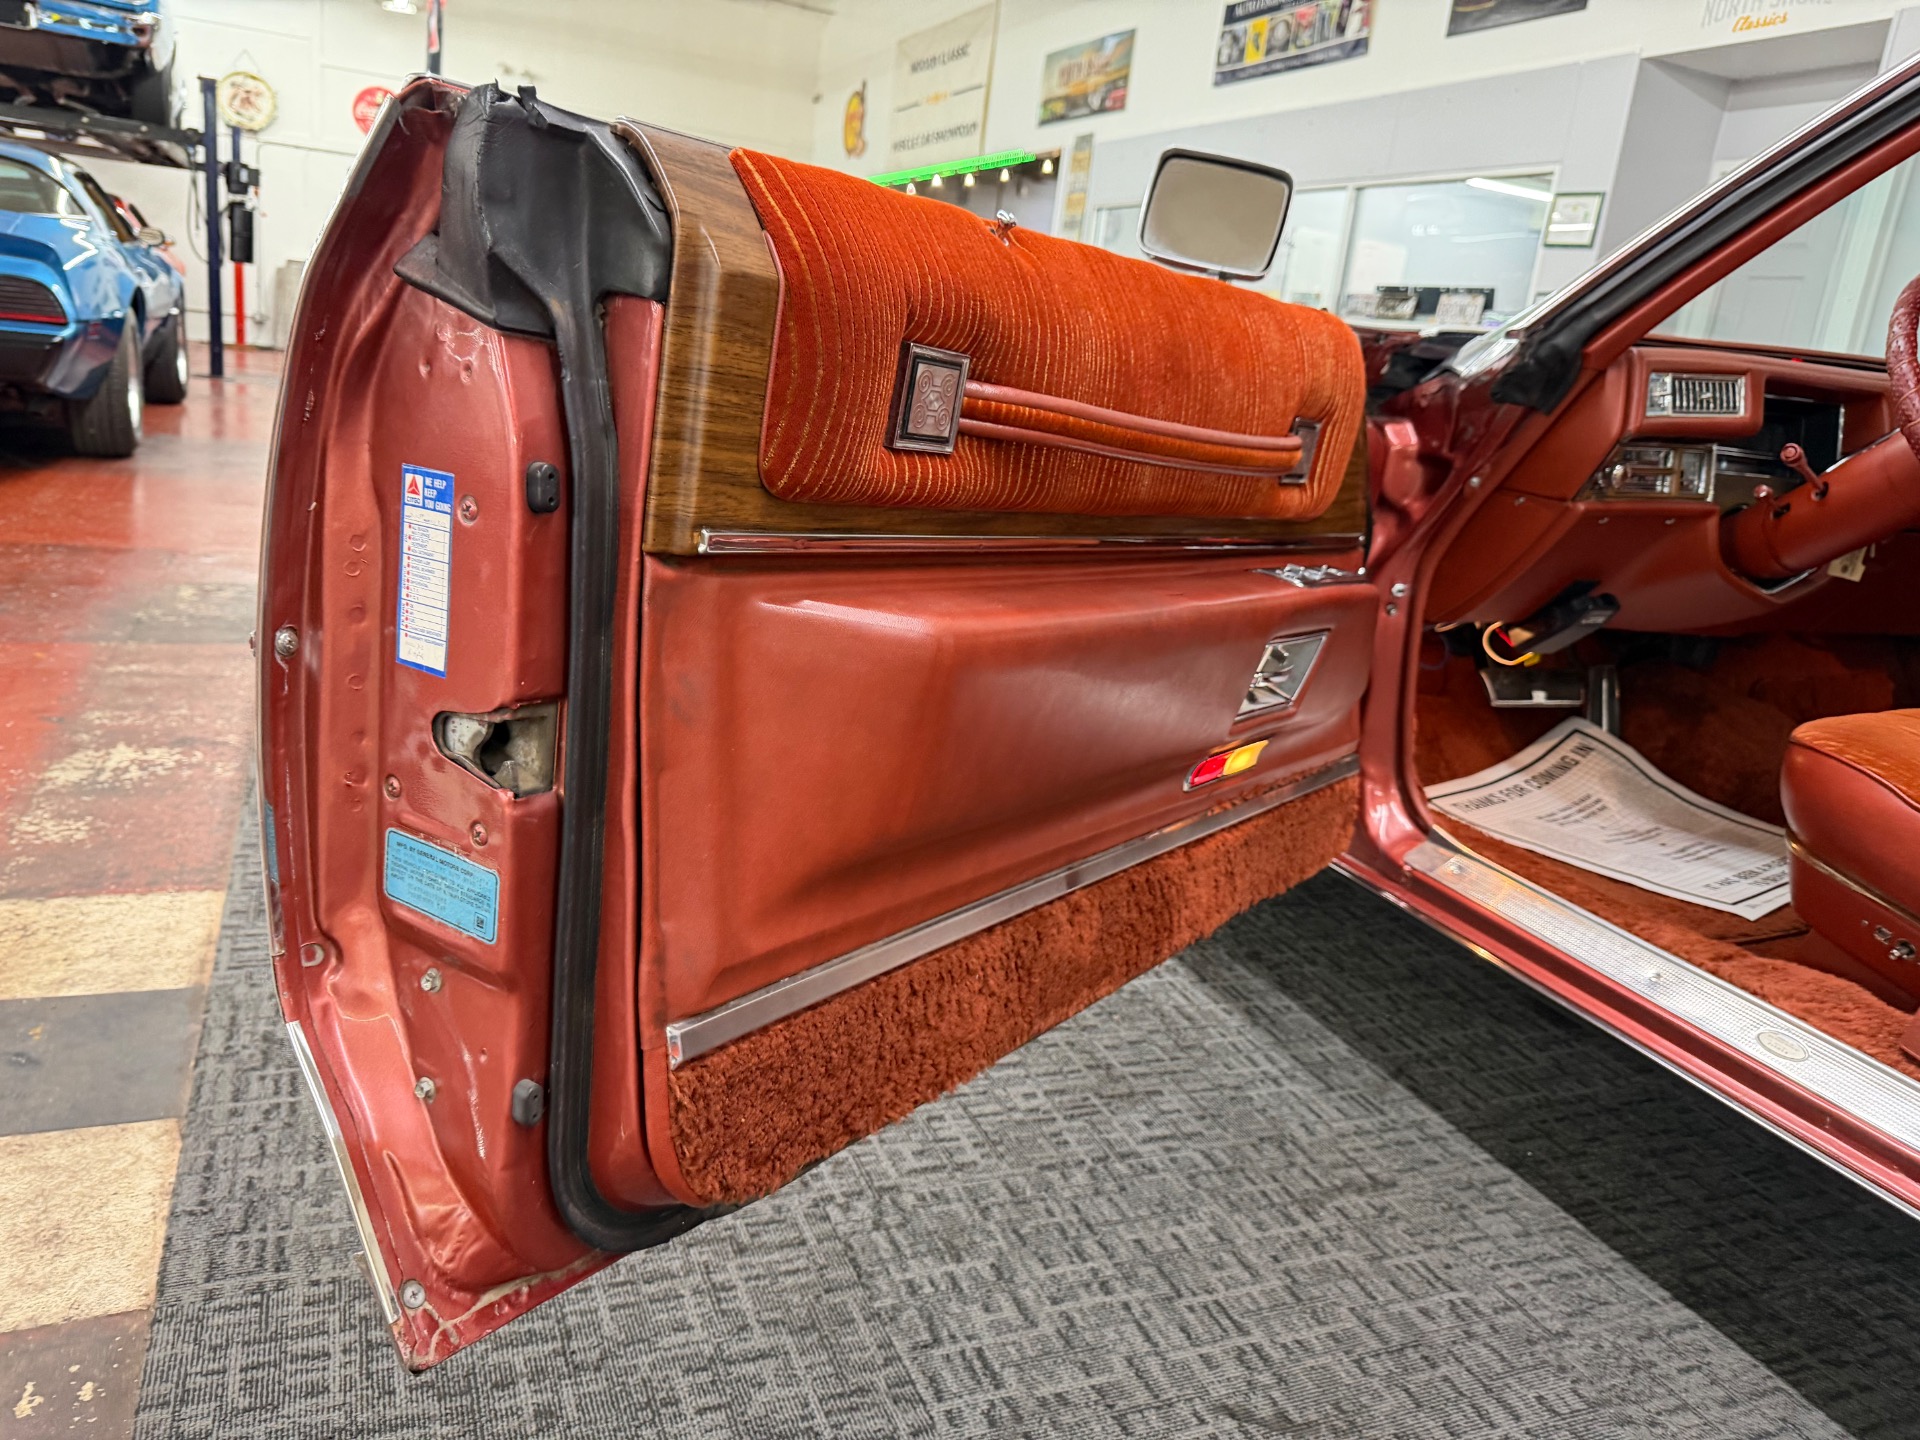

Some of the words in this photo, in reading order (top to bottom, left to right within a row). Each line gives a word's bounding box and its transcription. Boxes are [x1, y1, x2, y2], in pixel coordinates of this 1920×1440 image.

[1732, 12, 1788, 33] Classics
[433, 478, 447, 490] HELP
[424, 488, 437, 499] KEEP
[435, 501, 452, 513] GOING
[1523, 755, 1581, 790] COMING
[1569, 741, 1595, 759] IN
[417, 849, 439, 862] GENERAL
[439, 858, 460, 872] MOTORS
